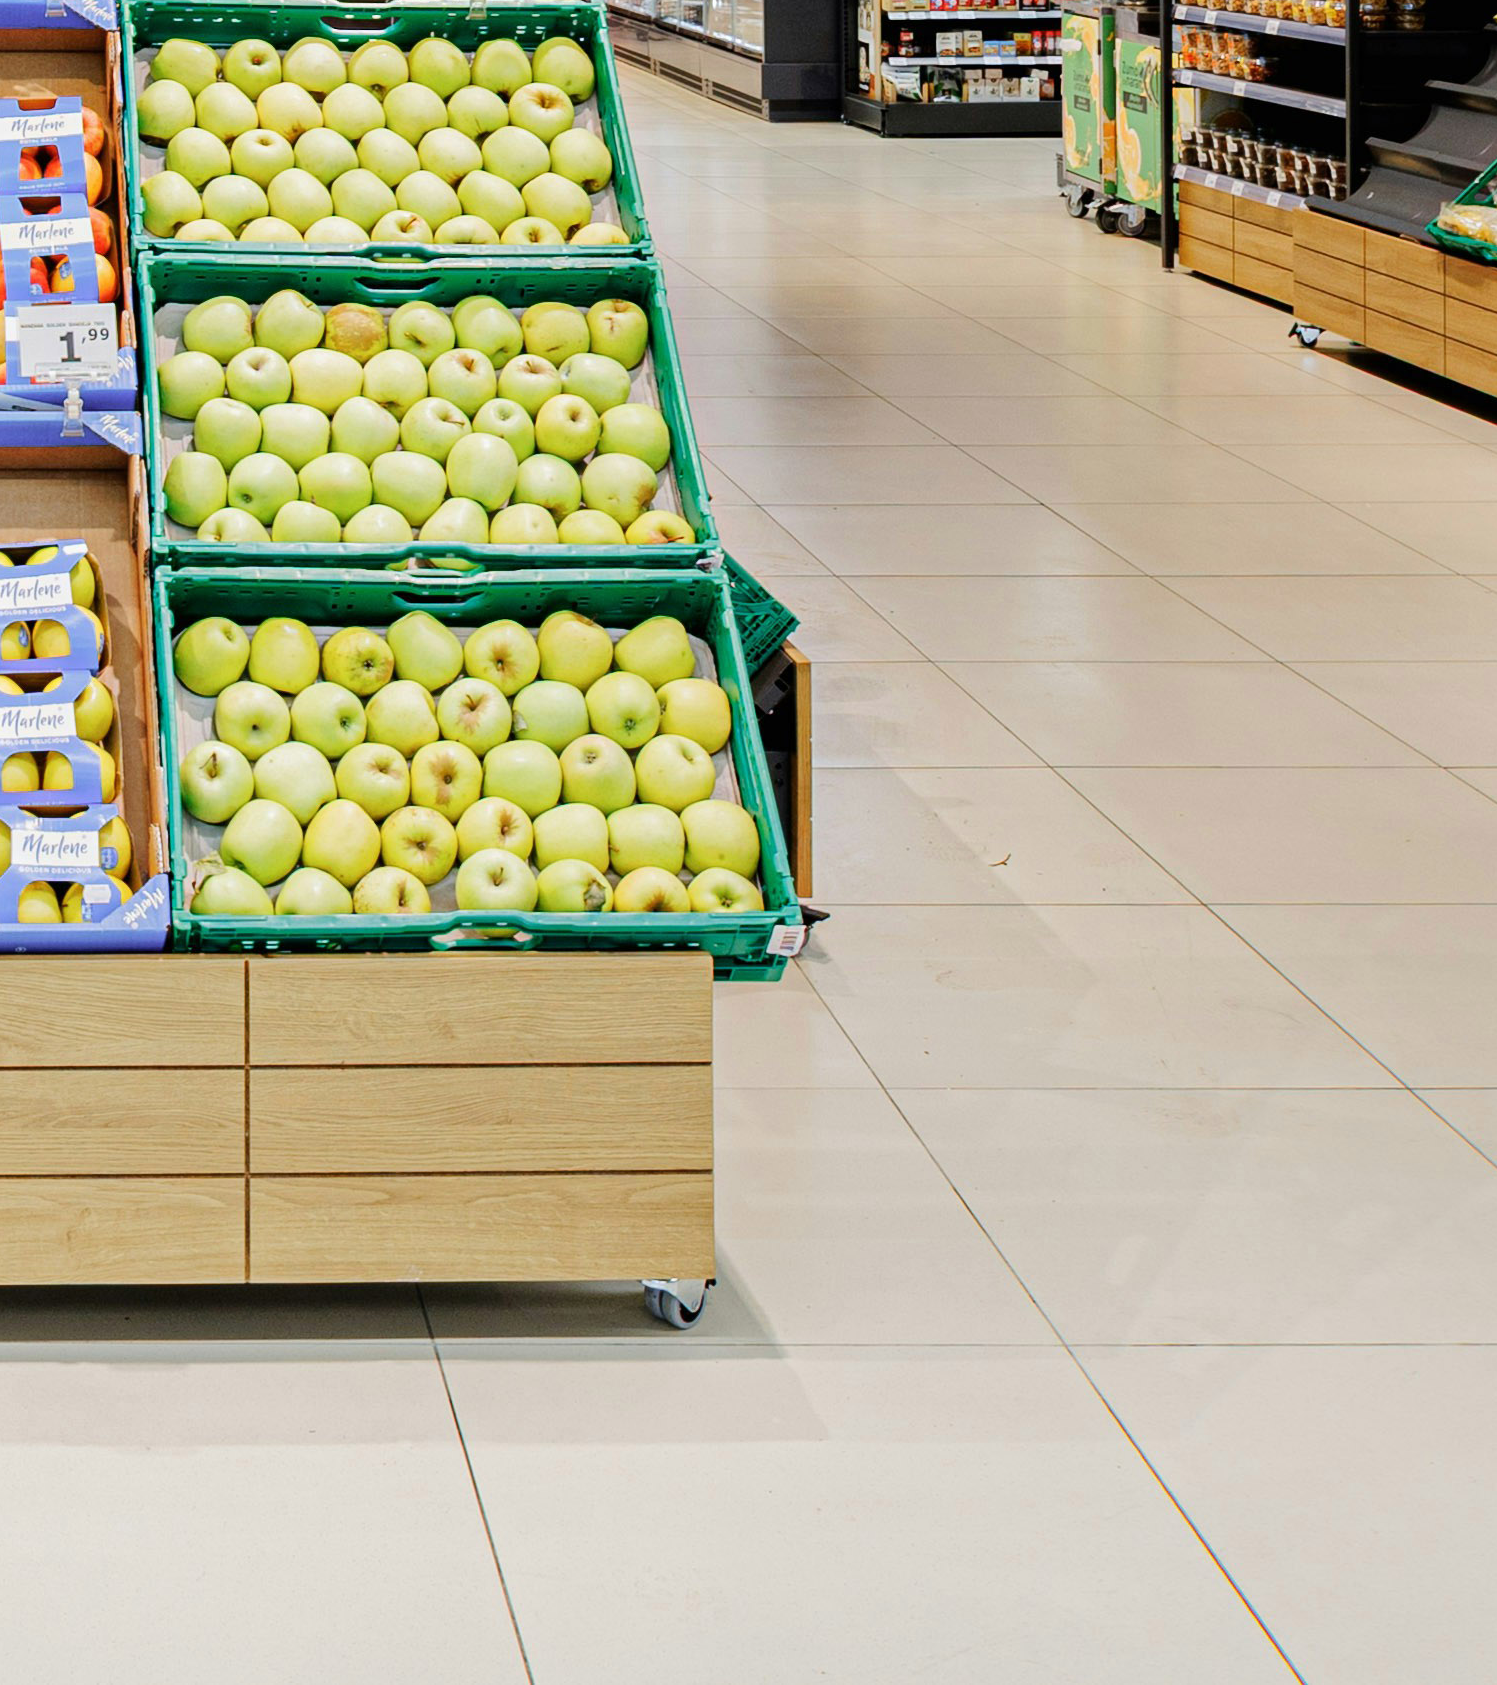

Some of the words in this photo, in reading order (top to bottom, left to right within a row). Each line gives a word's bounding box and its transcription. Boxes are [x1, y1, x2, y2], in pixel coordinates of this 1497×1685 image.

[11, 117, 66, 138] Marlene
[18, 224, 75, 245] Marlene
[59, 328, 110, 363] 1,99
[100, 414, 140, 445] Marlene
[0, 581, 62, 606] Marlene
[29, 606, 66, 615] DELICIOUS
[1, 711, 65, 737] Marlene
[0, 739, 30, 747] GOLDEN
[31, 736, 70, 745] DELICIOUS
[22, 834, 88, 862] Marlene
[18, 866, 50, 875] GOLDEN
[52, 866, 92, 875] DELICIOUS
[123, 887, 167, 928] Marlene
